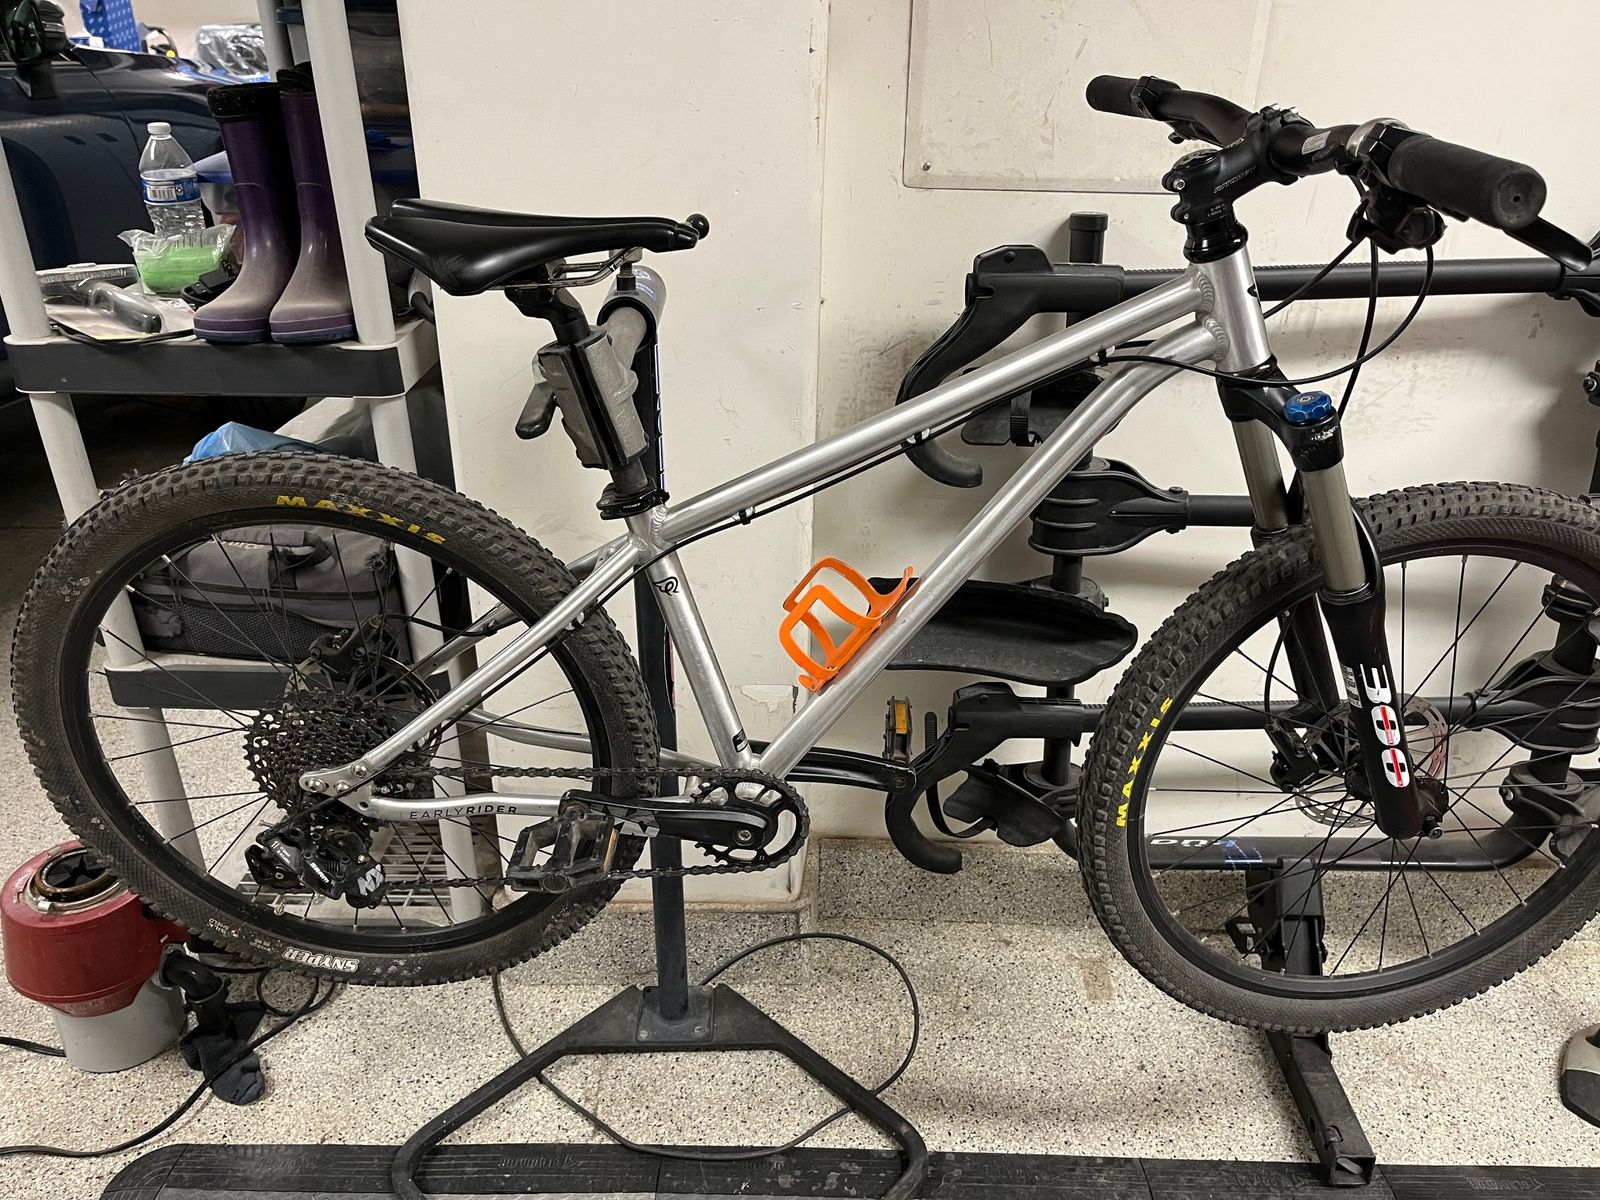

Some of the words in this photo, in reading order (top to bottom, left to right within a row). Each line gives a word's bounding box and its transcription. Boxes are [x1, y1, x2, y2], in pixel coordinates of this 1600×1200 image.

[276, 495, 446, 545] MAXXIS
[1116, 697, 1173, 827] MAXXIS
[281, 946, 361, 973] SNYPER
